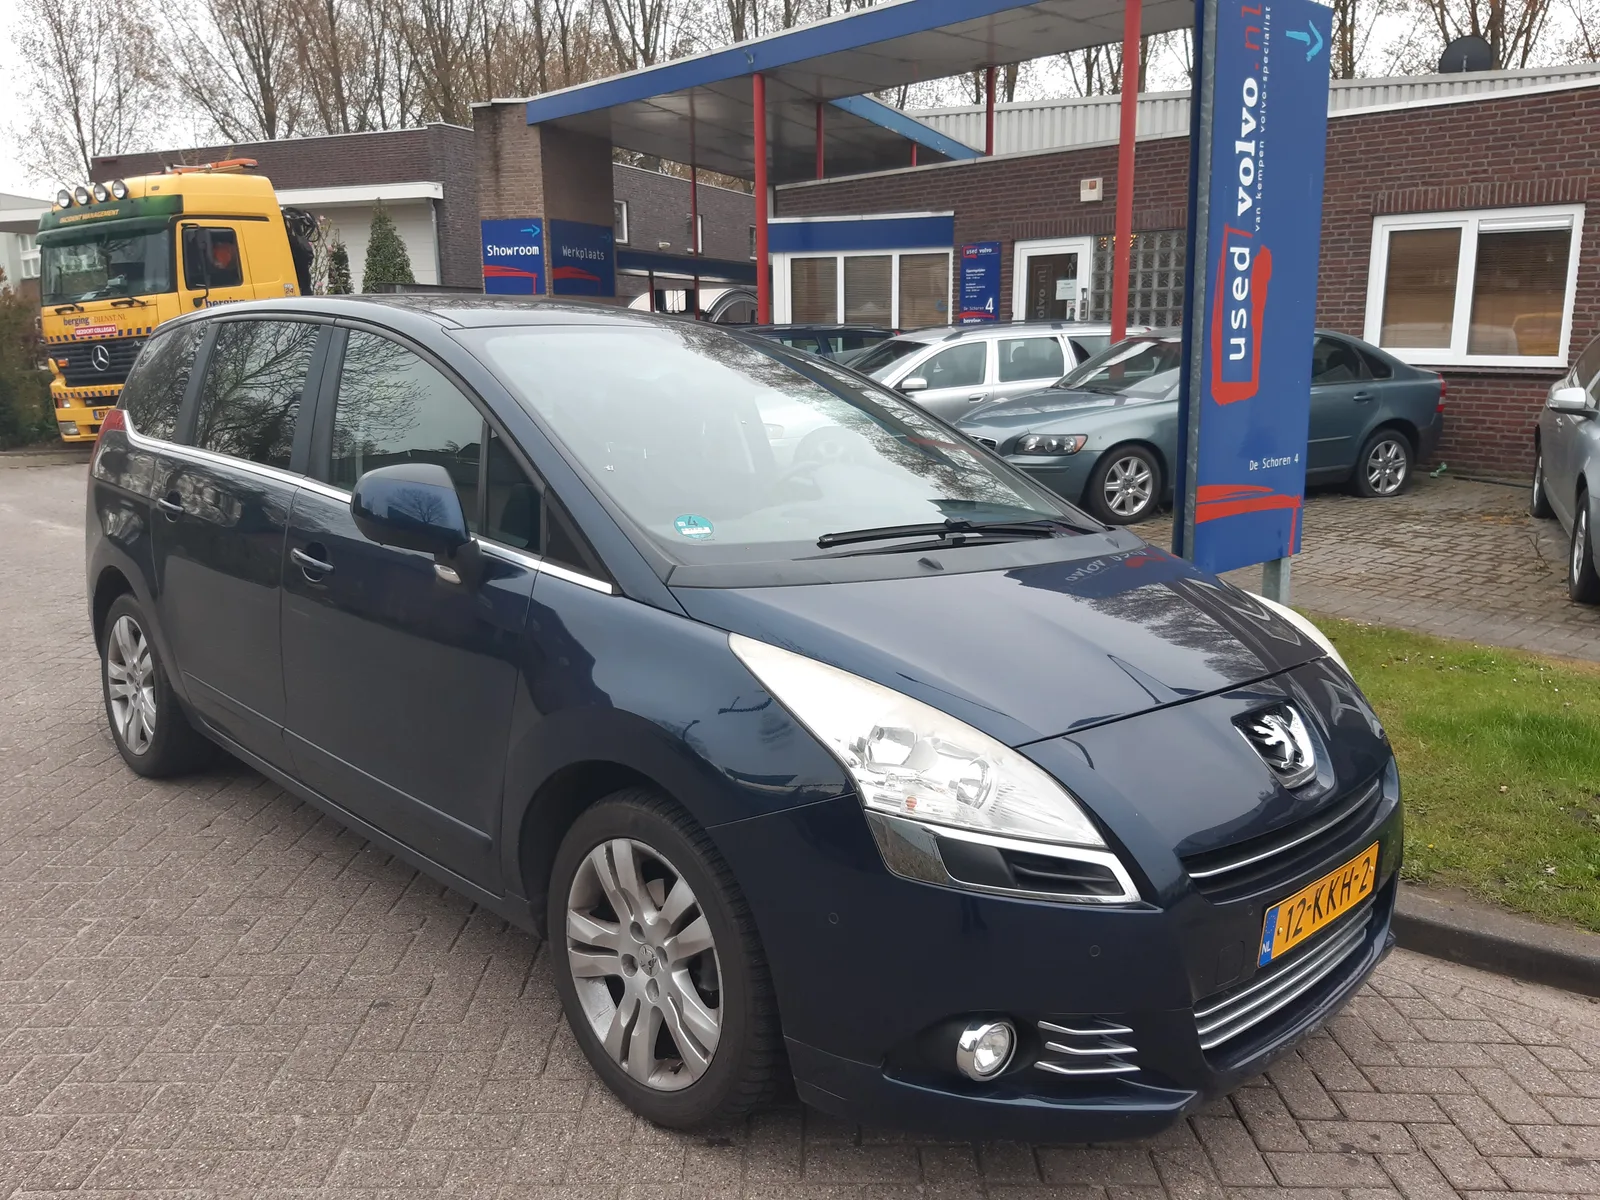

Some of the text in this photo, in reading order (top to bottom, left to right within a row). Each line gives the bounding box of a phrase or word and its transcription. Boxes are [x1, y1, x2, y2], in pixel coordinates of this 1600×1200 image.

[1254, 6, 1272, 232] van kempen volvo-specialist
[486, 244, 540, 256] Showroom
[562, 245, 605, 261] Werkplaats
[985, 297, 994, 314] 4
[1229, 245, 1251, 362] used
[63, 316, 90, 327] berging
[1249, 453, 1299, 471] De Schoren 4
[1285, 856, 1370, 943] 12-KKH-2
[1260, 940, 1272, 954] NL
